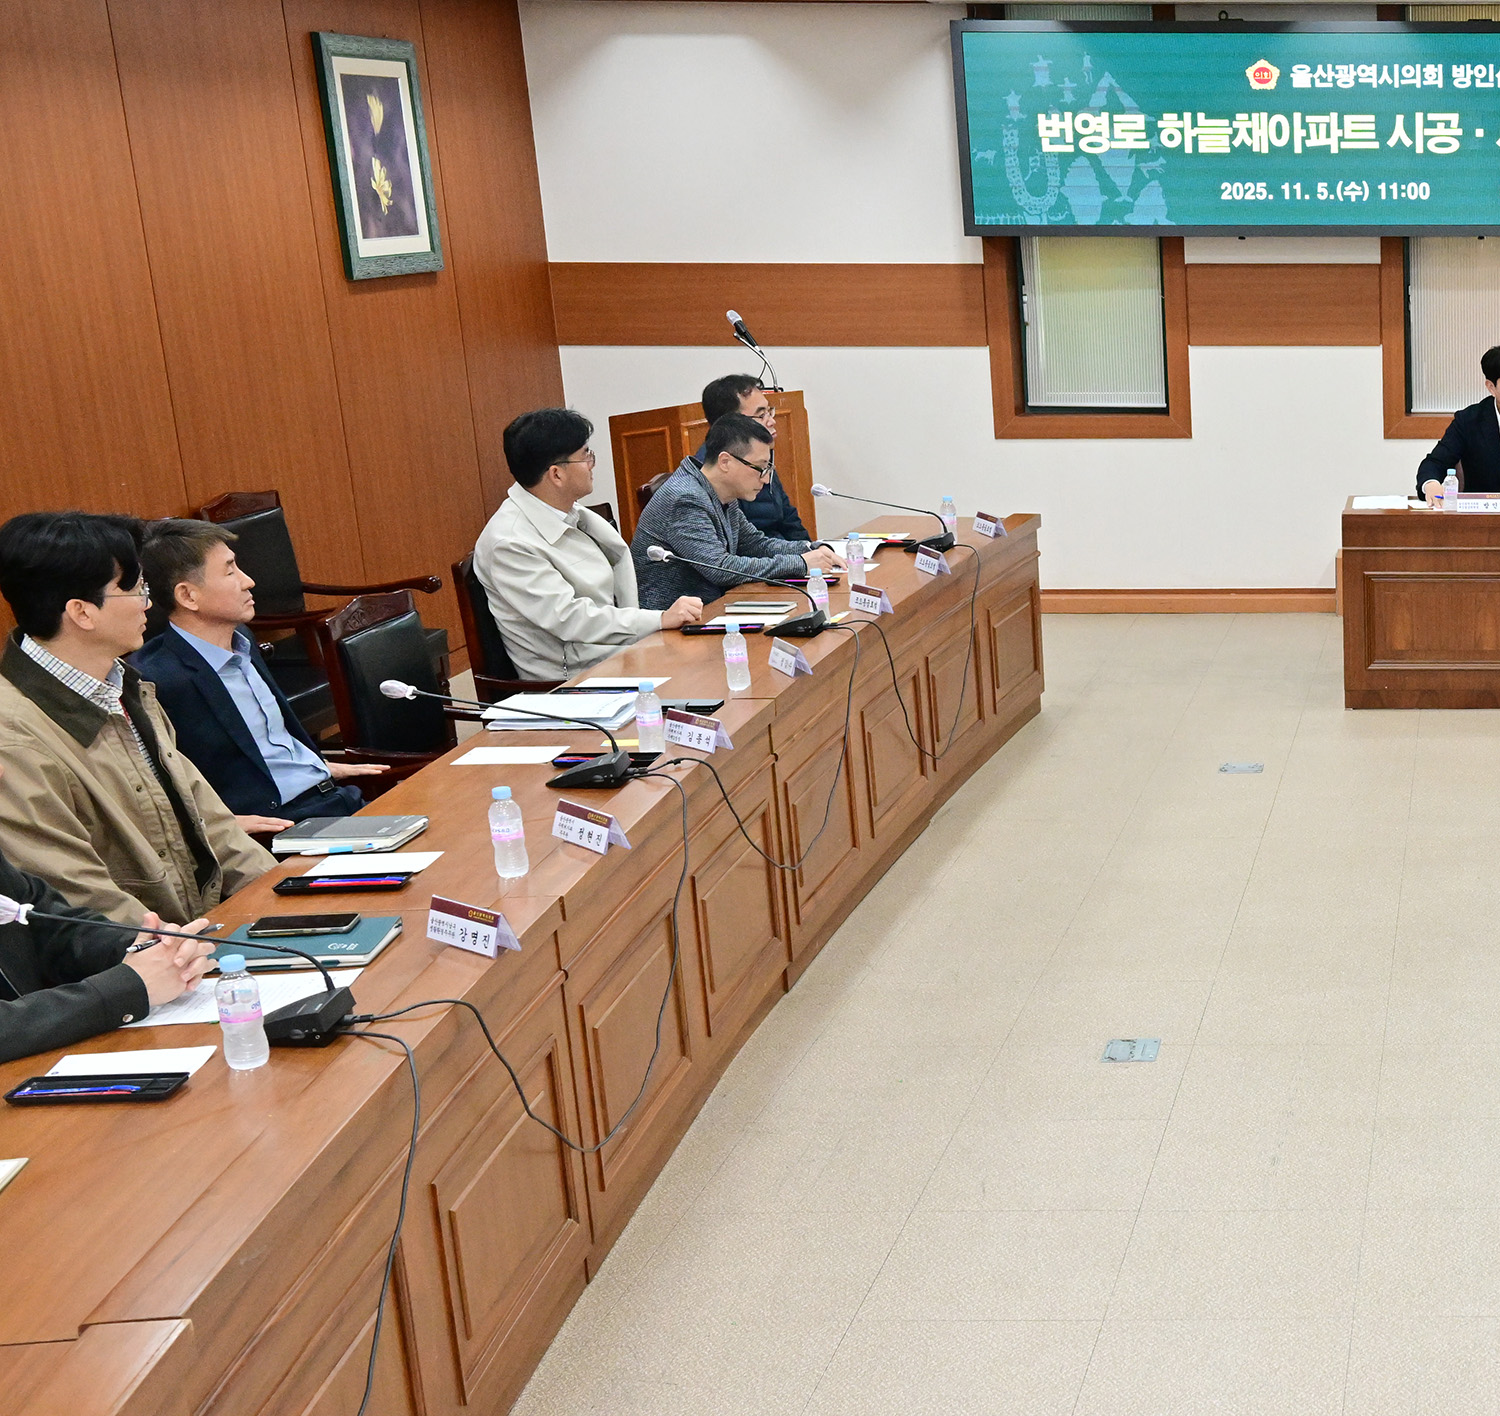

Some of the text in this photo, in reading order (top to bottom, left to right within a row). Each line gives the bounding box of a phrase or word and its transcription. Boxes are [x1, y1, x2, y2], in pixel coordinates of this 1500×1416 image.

[1255, 71, 1272, 80] 의회
[1290, 63, 1443, 89] 울산광역시의회
[1037, 111, 1150, 154] 번영로
[1157, 111, 1380, 154] 하늘채아파트
[1386, 111, 1463, 154] 시공
[1220, 180, 1431, 202] 2025. 11. 5.(수) 11:00
[459, 927, 491, 949] 강명진
